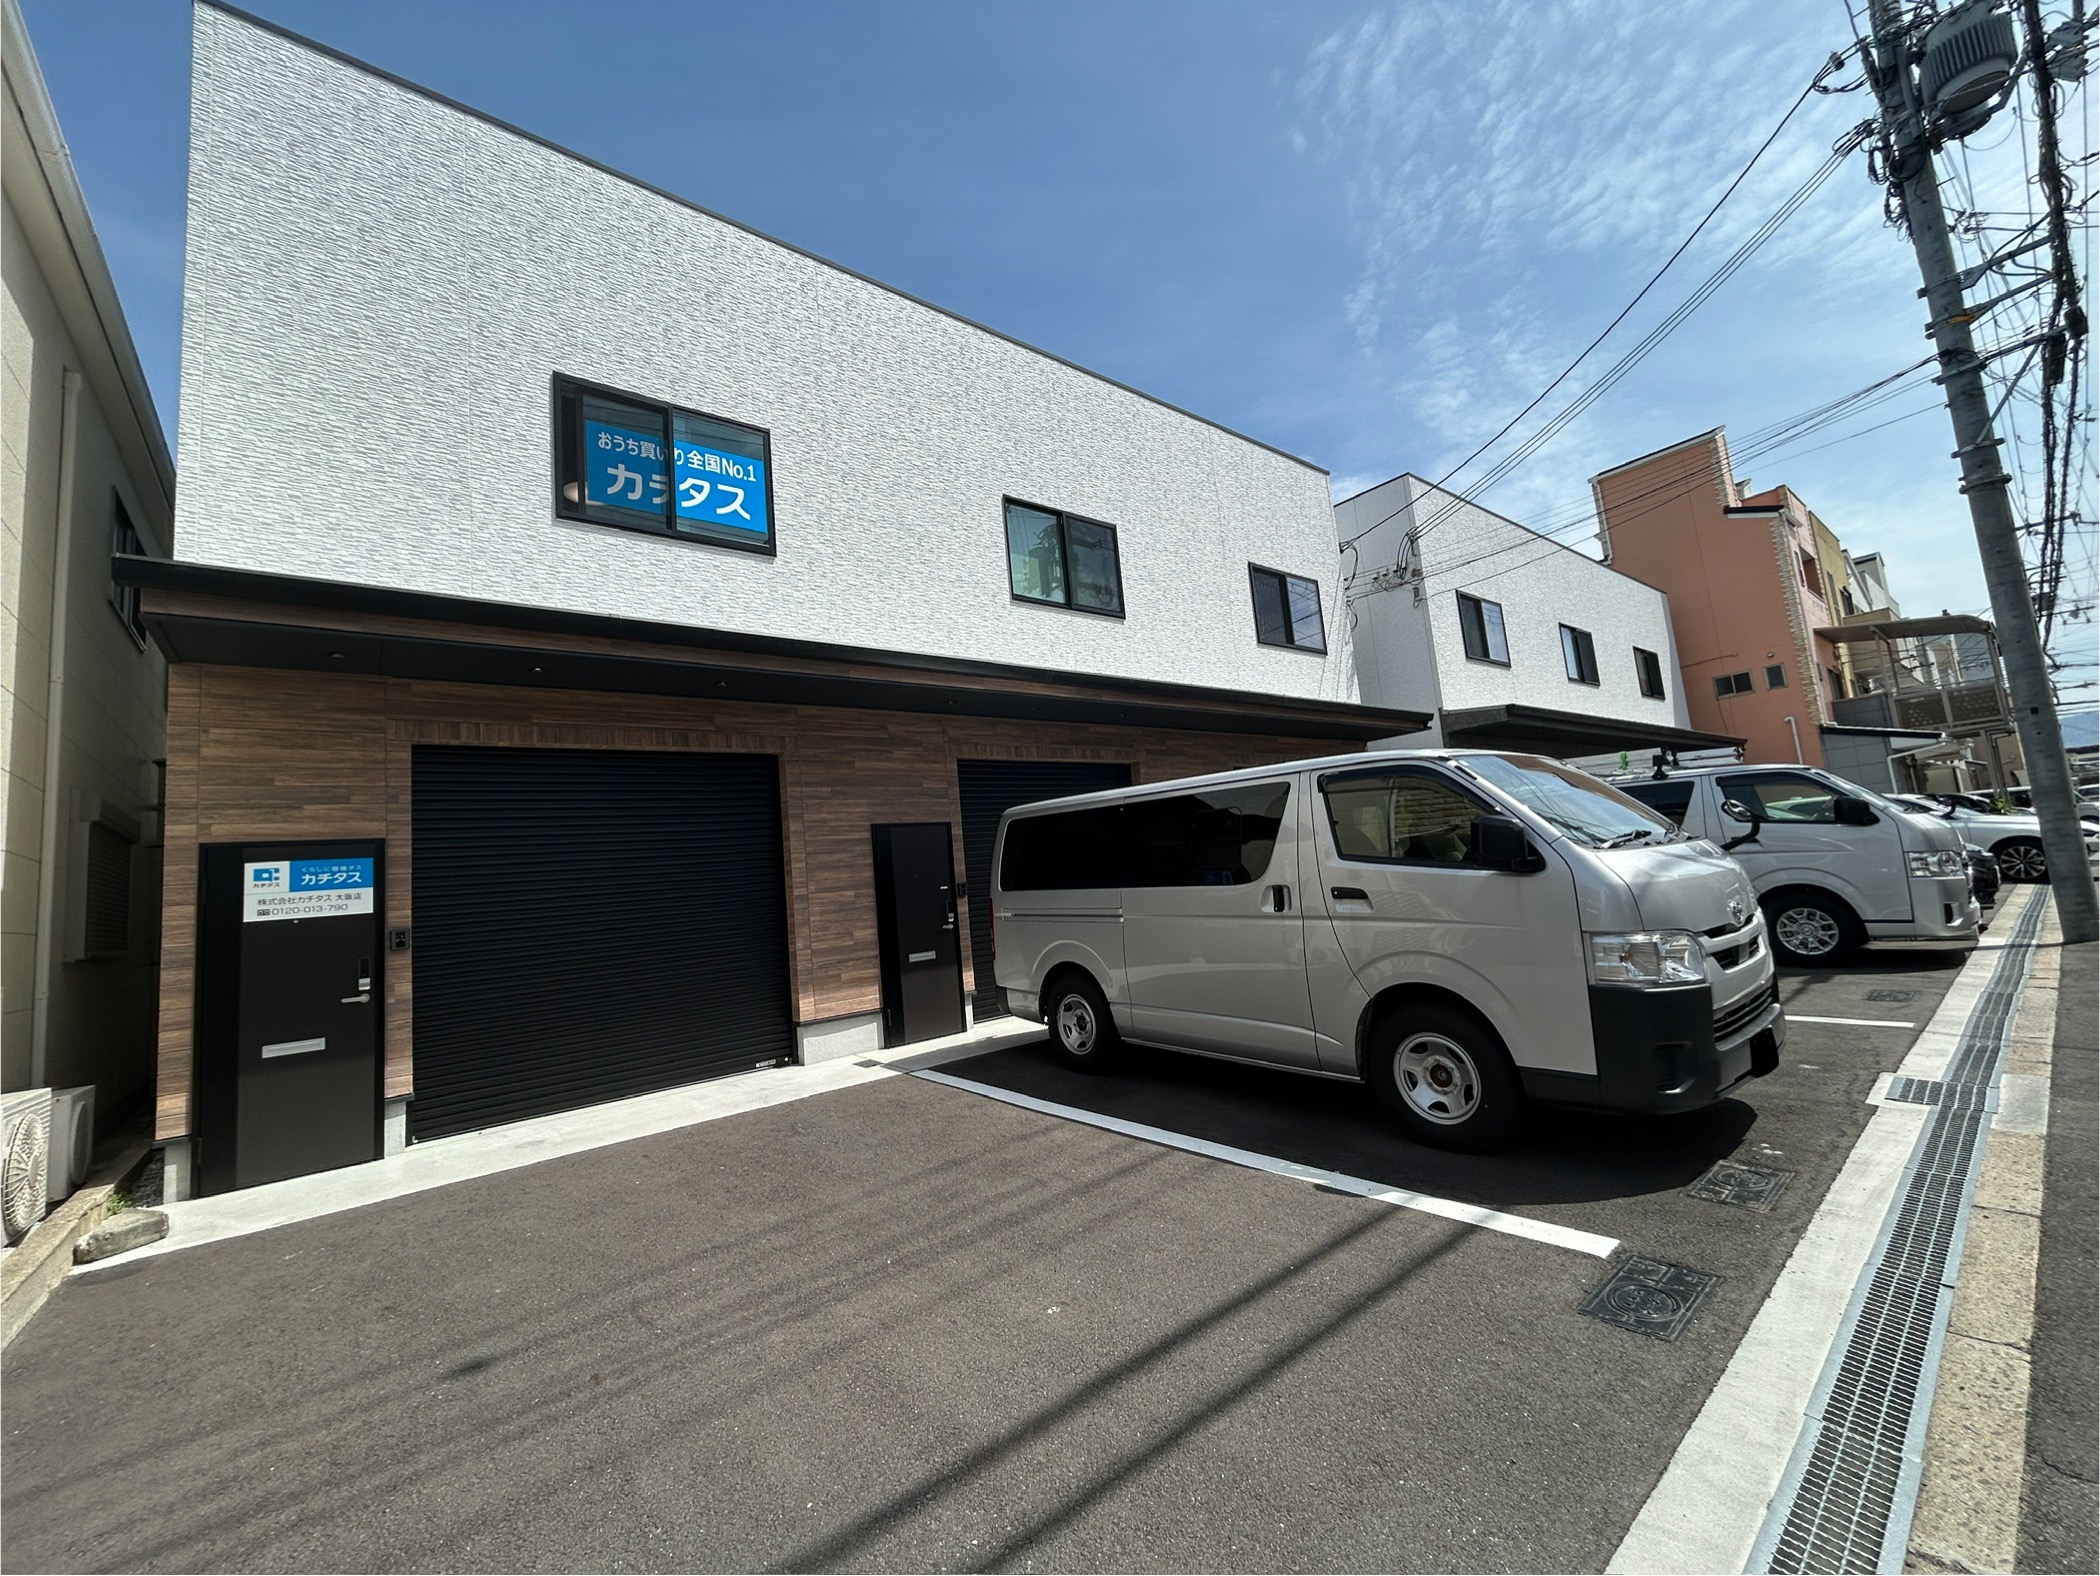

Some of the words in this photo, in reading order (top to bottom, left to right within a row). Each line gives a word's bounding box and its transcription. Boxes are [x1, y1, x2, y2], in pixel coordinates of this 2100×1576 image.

[301, 872, 362, 885] カチタス
[257, 895, 332, 906] 株式会社カチタス
[335, 893, 362, 901] 大阪店
[272, 904, 348, 915] 0120-013-790
